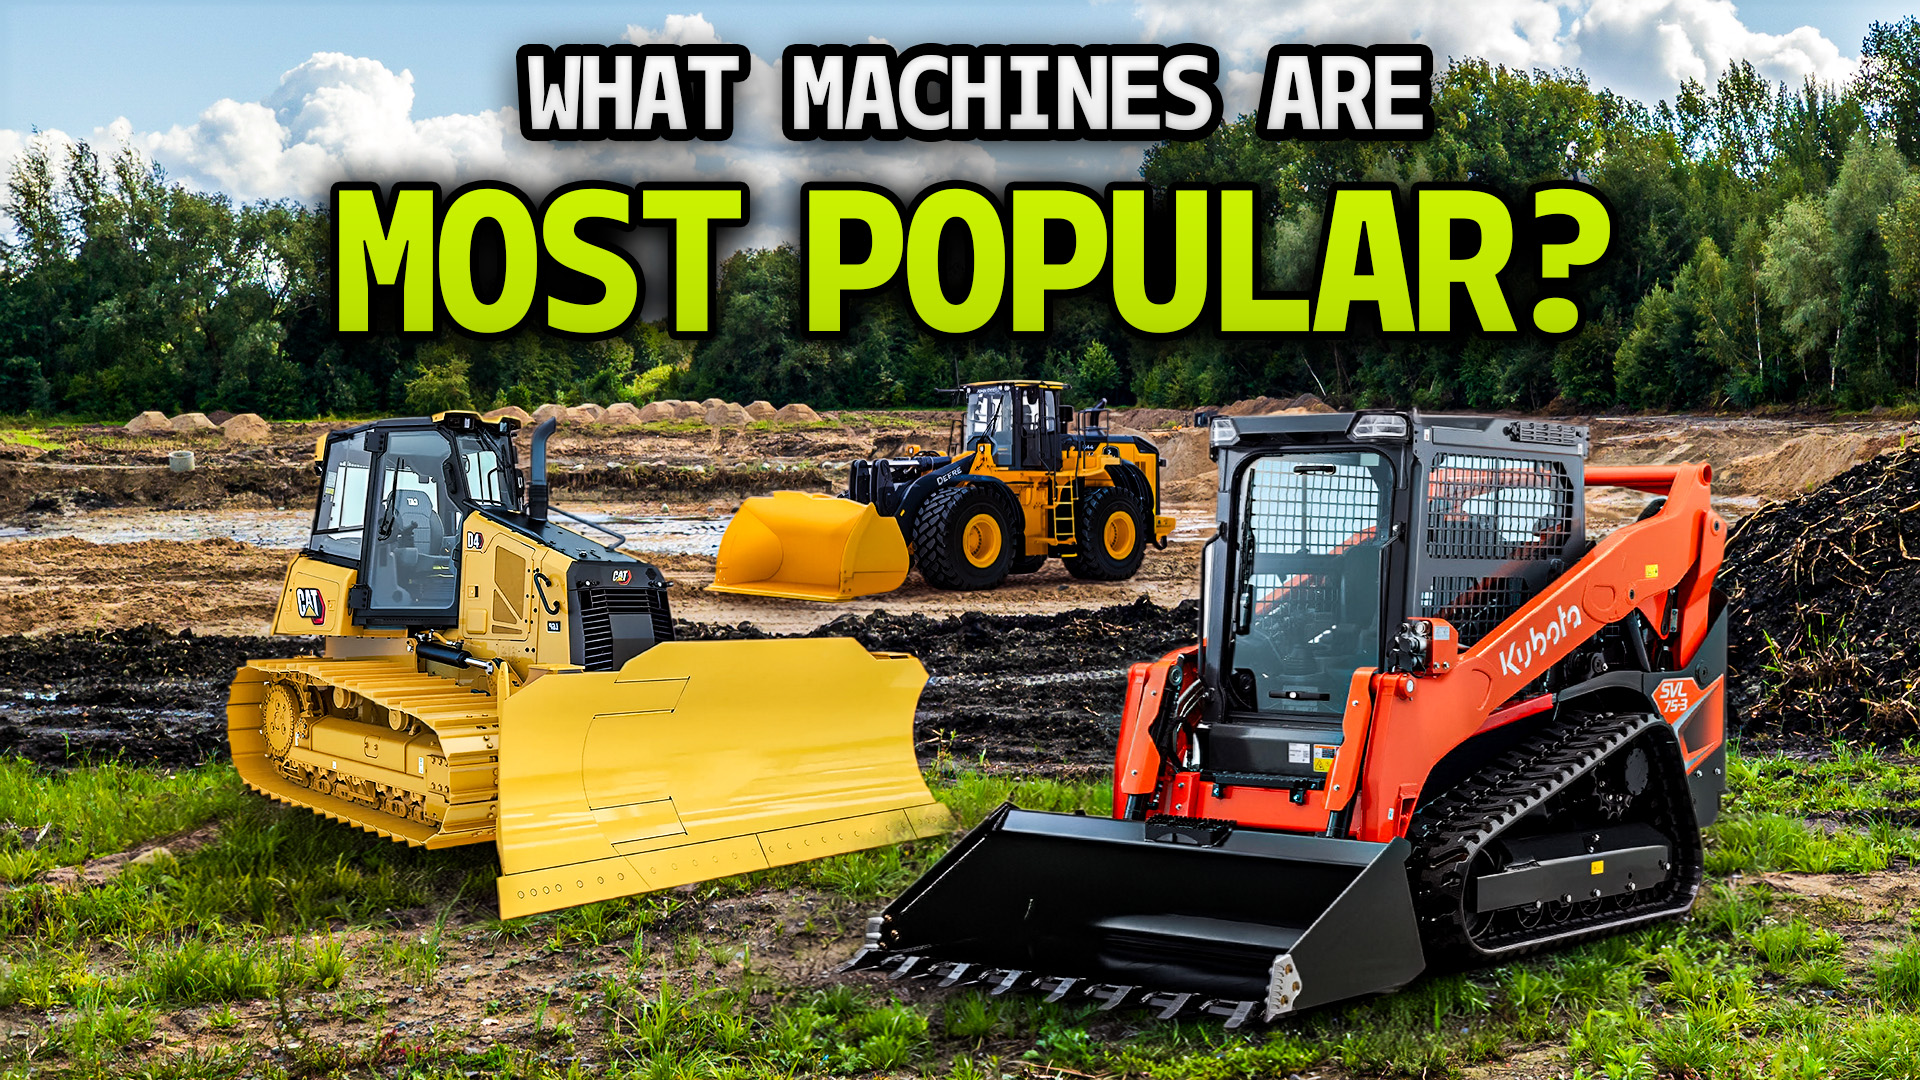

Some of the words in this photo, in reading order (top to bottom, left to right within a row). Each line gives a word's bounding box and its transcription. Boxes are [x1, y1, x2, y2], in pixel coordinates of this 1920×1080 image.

[467, 532, 480, 549] D4
[612, 569, 628, 582] CAT
[296, 588, 319, 617] CAT
[1499, 604, 1582, 676] Kubota
[1659, 681, 1688, 699] SVL
[1664, 698, 1688, 713] 75-3
